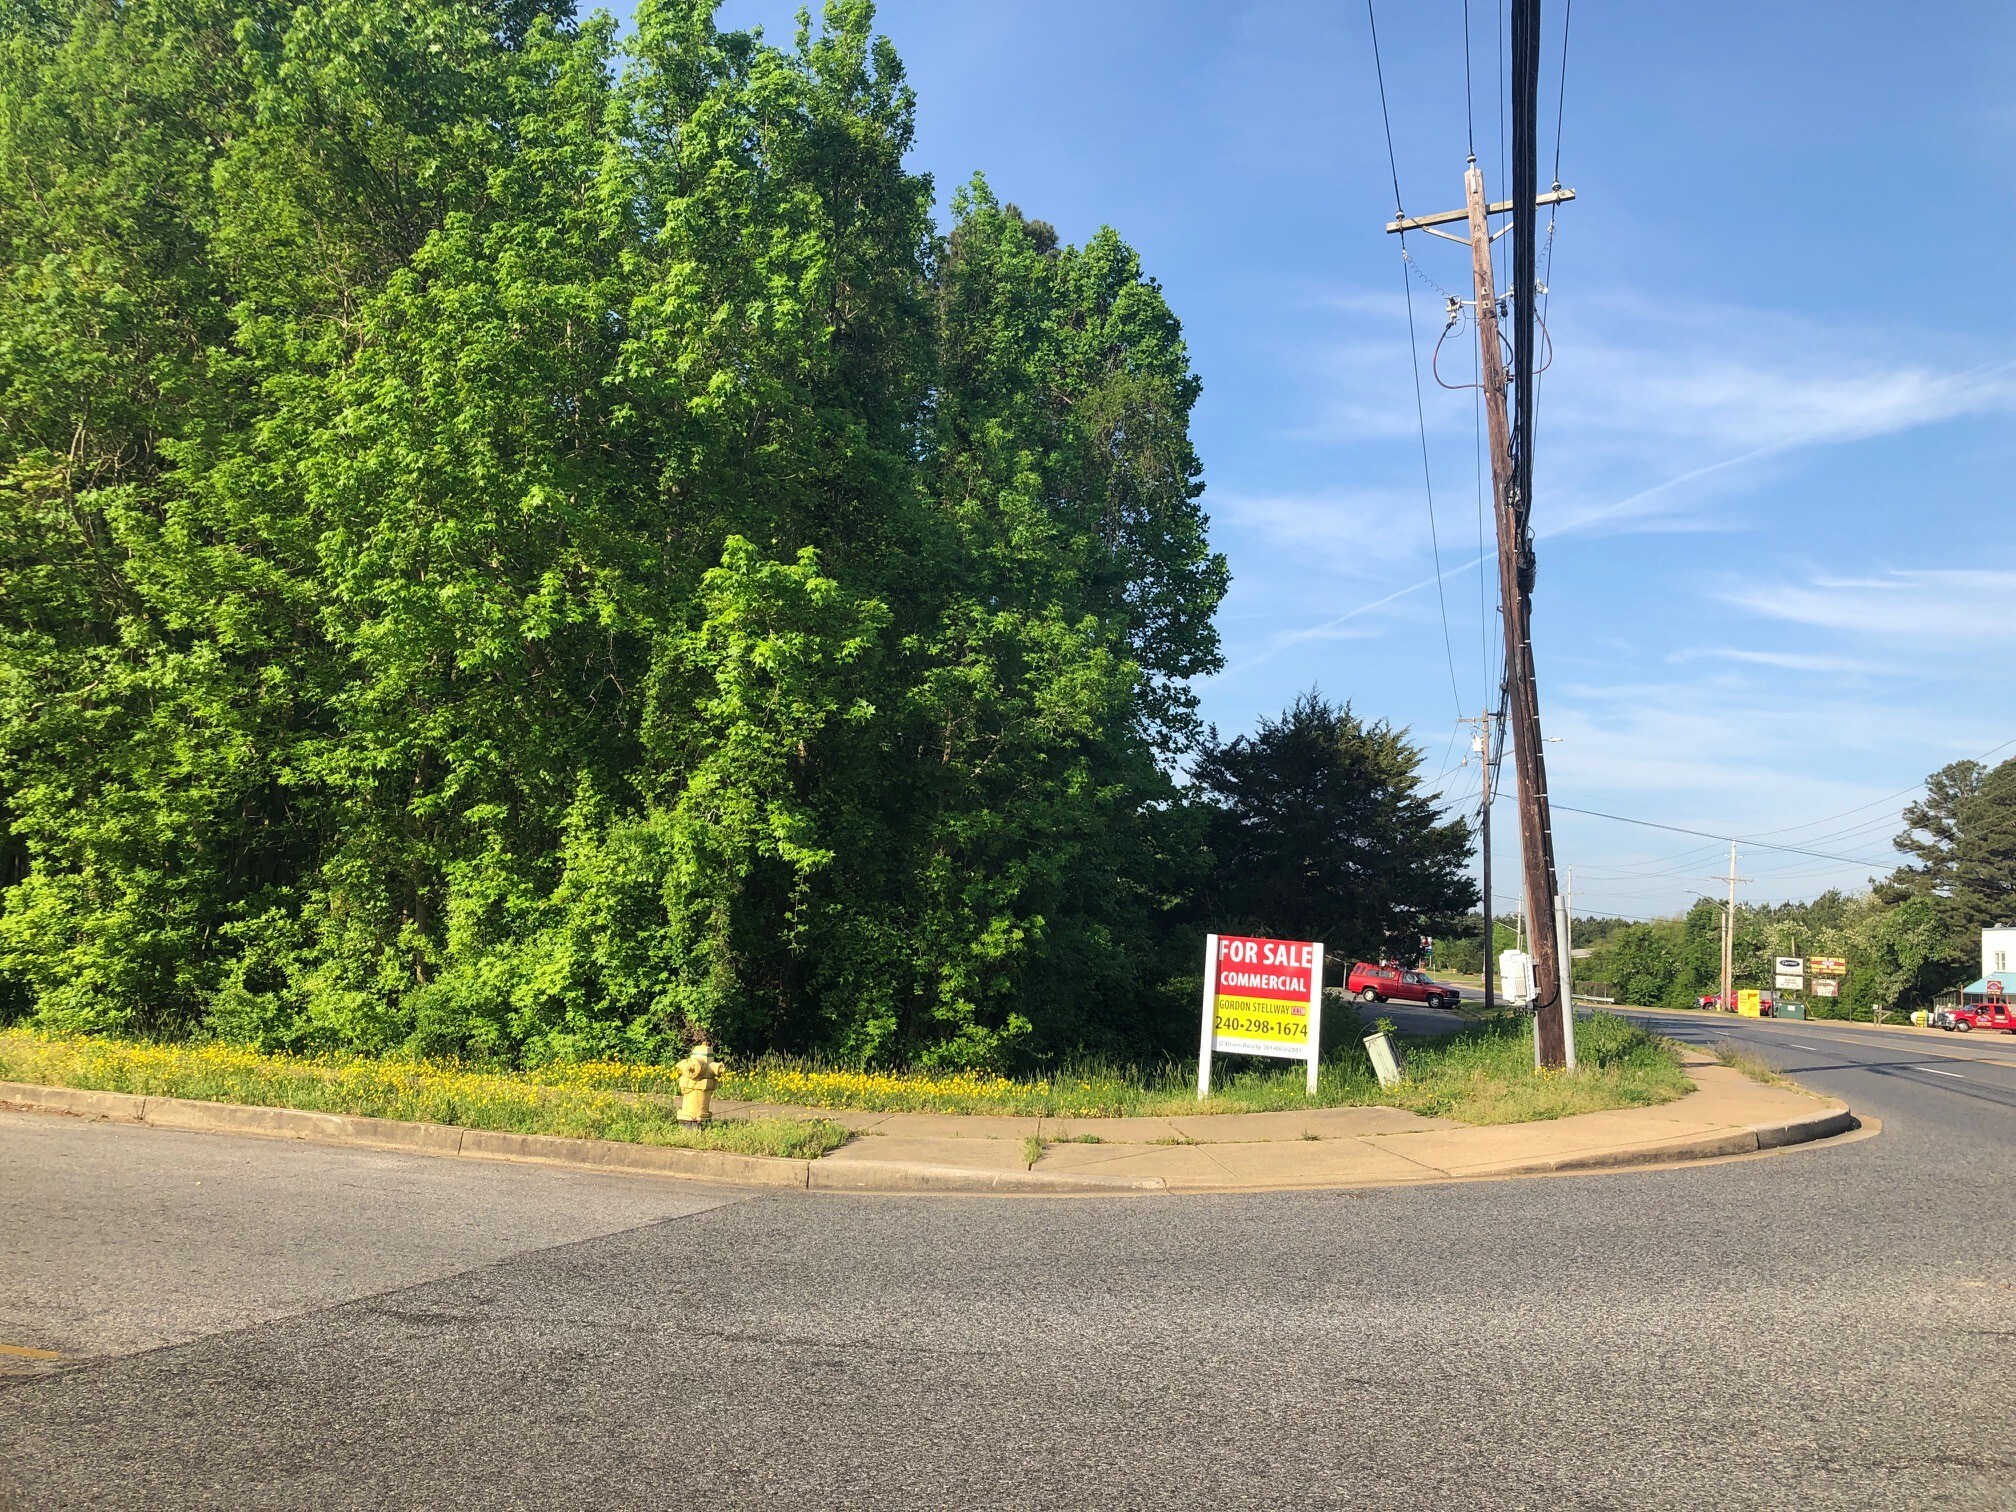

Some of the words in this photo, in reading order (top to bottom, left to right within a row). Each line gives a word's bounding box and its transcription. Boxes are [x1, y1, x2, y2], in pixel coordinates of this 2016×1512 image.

[1219, 939, 1258, 964] FOR
[1263, 943, 1312, 968] SALE
[1220, 971, 1306, 992] COMMERCIAL
[1219, 999, 1251, 1012] GORDON
[1252, 1002, 1291, 1015] STELLWAY
[1242, 1042, 1262, 1050] Realty
